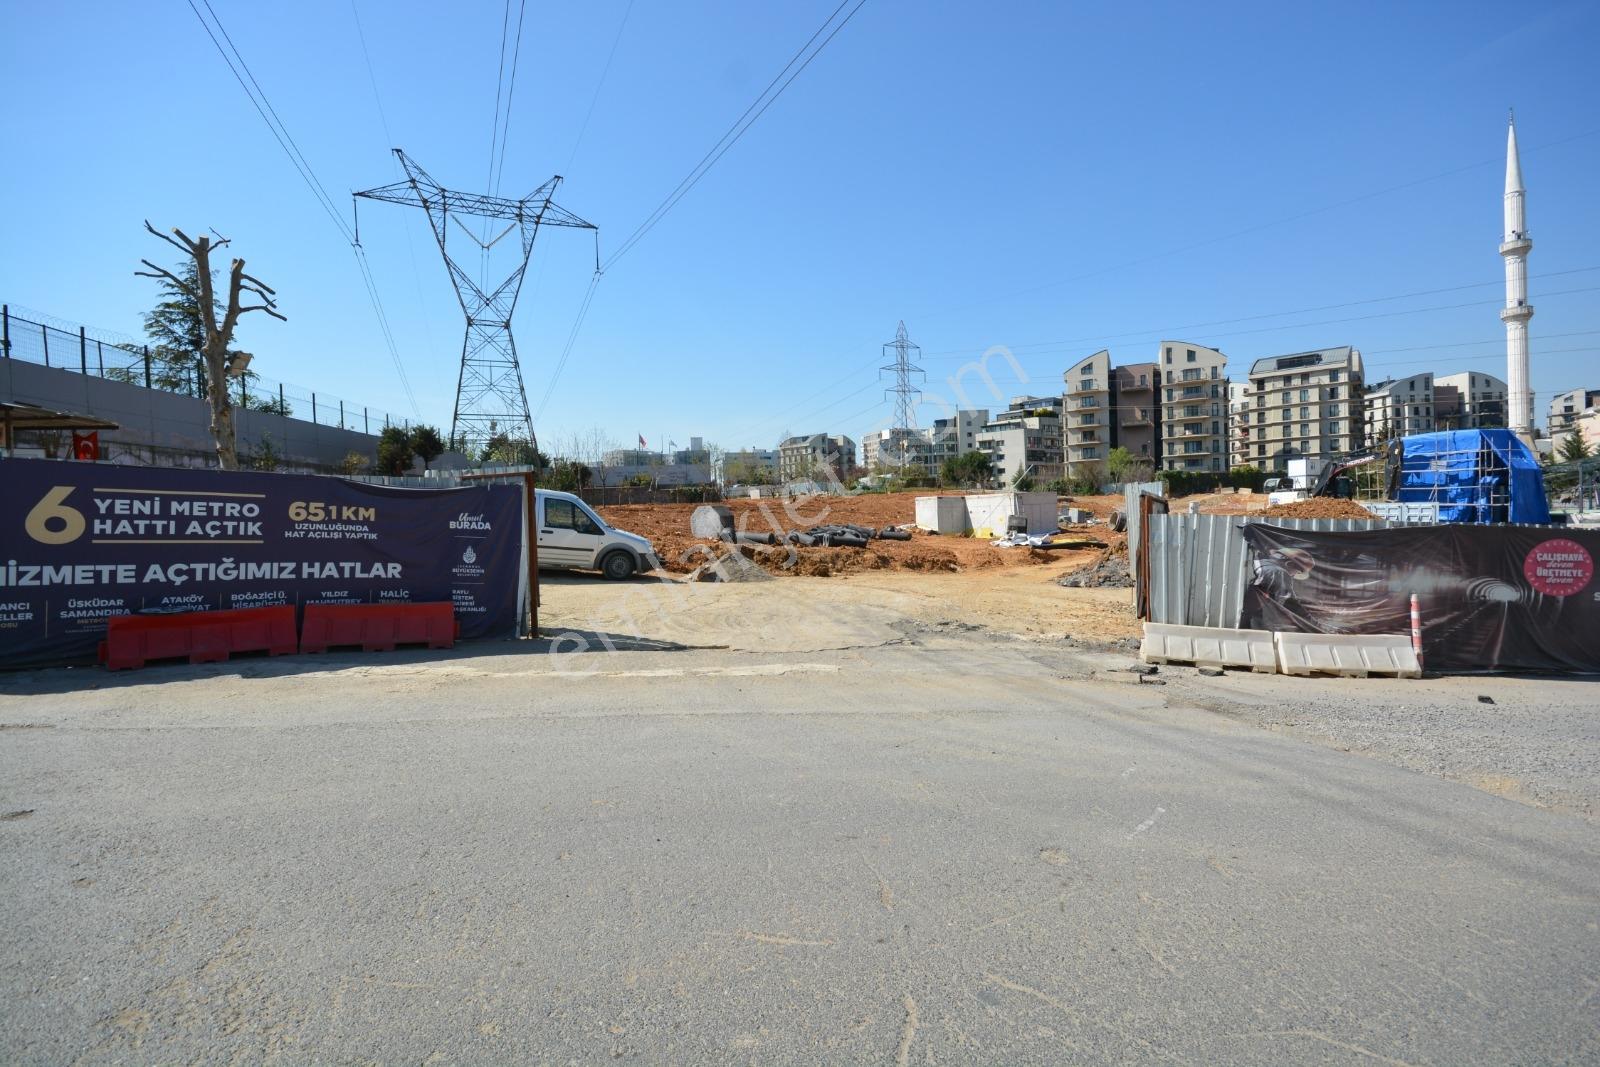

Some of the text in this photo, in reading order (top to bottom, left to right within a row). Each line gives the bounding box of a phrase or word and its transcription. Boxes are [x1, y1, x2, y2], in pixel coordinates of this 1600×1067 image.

[93, 497, 260, 518] YENİ METRO
[288, 501, 376, 522] 65,1 KM
[25, 486, 86, 545] 6
[93, 519, 263, 538] HATTI AÇTIK
[294, 523, 369, 532] UZUNLUĞUNDA
[449, 521, 492, 530] BURADA
[307, 532, 342, 540] AÇILIŞI
[345, 532, 378, 540] YAPTIK
[1536, 552, 1584, 562] ÇALIŞMAYA
[142, 557, 297, 586] AÇTIĞIMIZ
[302, 562, 402, 579] HATLAR
[1536, 567, 1583, 577] ÜRETMEYE
[231, 591, 277, 601] BOĞAZİÇİ
[321, 590, 349, 598] YILDIZ
[380, 588, 410, 599] HALİÇ
[68, 597, 124, 608] ÜSKÜDAR
[161, 594, 204, 604] ATAKÖY
[60, 609, 131, 619] SAMANDIRA
